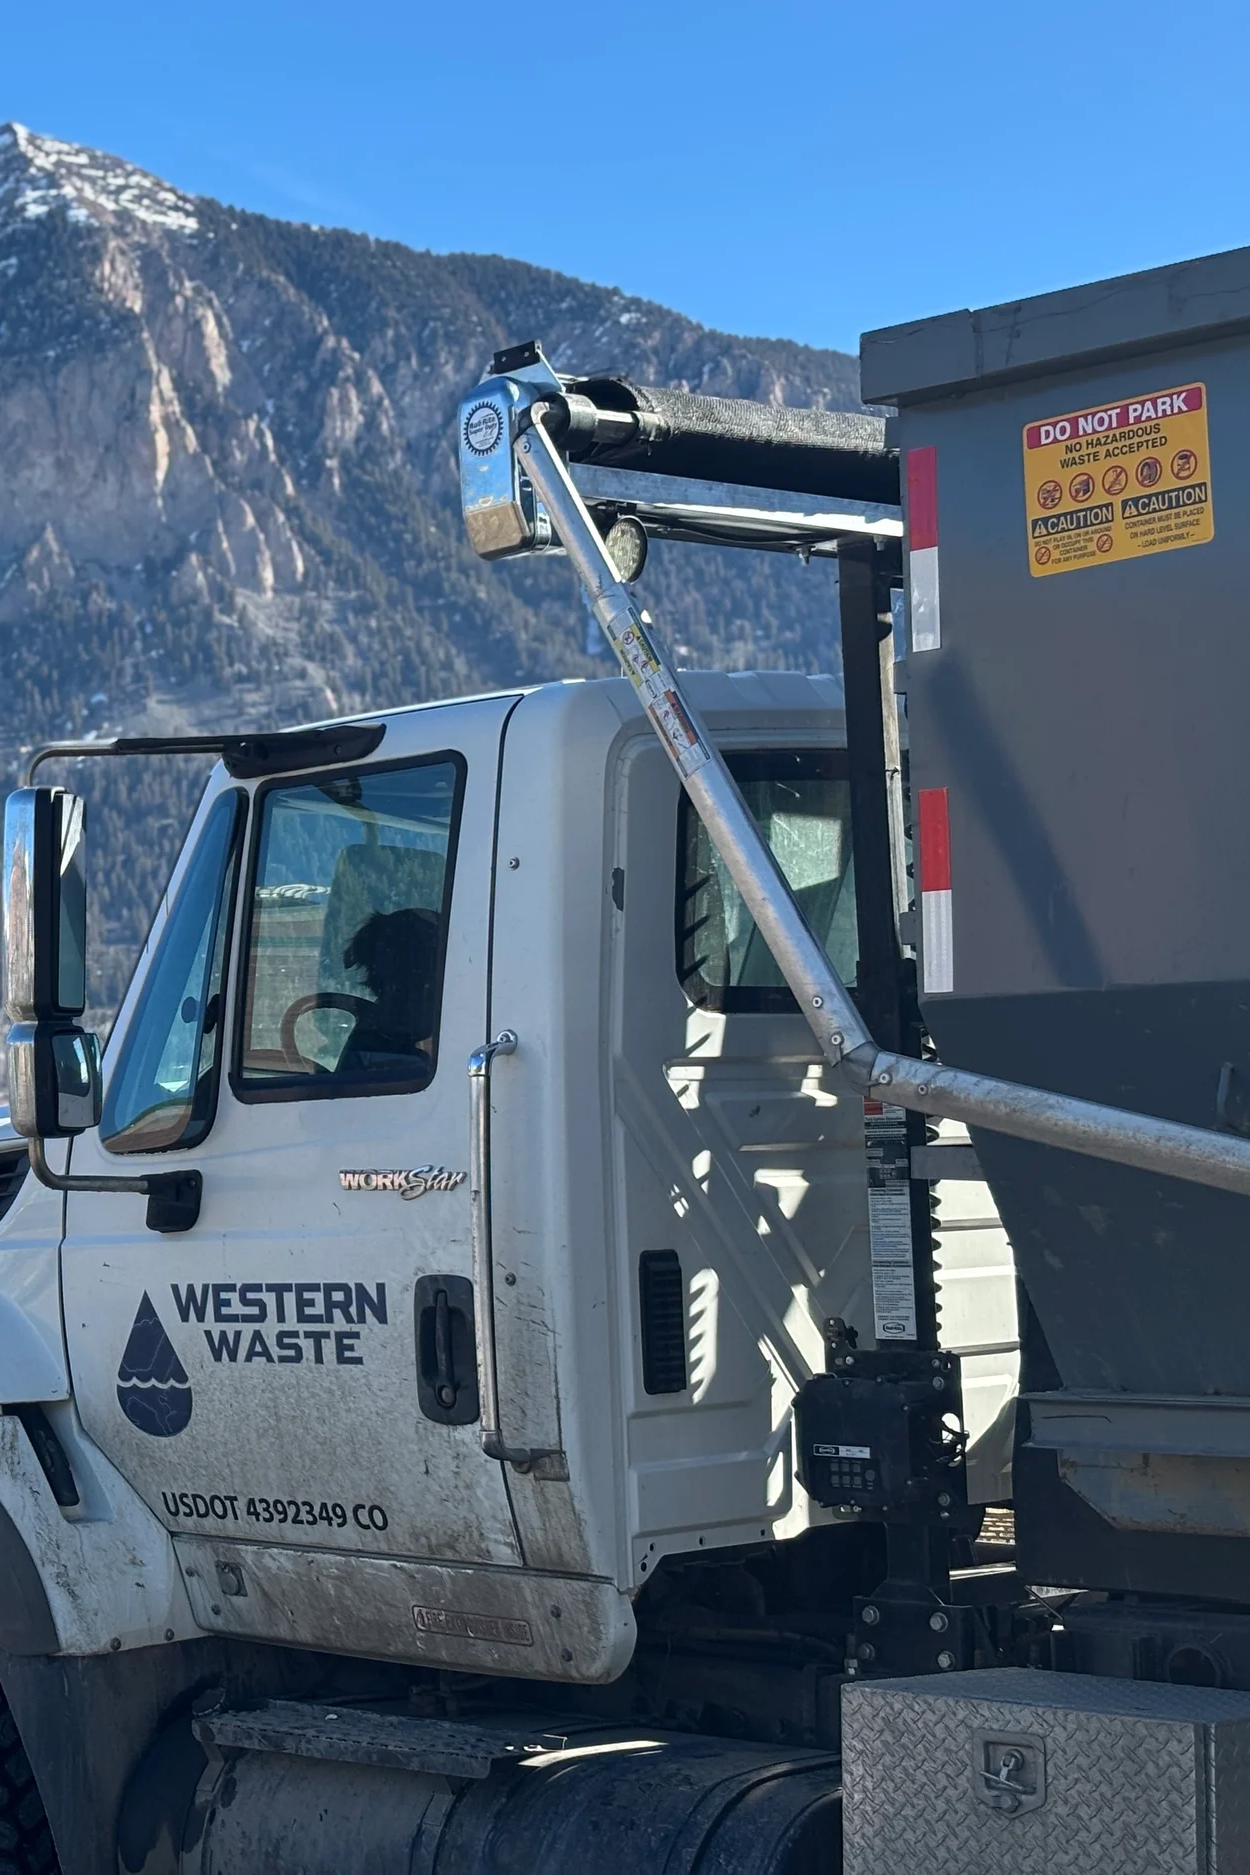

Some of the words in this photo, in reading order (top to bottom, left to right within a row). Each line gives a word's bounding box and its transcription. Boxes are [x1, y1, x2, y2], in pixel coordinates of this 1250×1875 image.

[1040, 421, 1070, 445] DO
[1078, 407, 1120, 436] NOT
[1128, 392, 1188, 424] PARK
[1060, 451, 1100, 469] WASTE
[1104, 436, 1168, 460] ACCEPTED
[1065, 442, 1082, 455] NO
[1086, 423, 1161, 450] HAZARDOUS
[1138, 486, 1206, 513] CAUTION
[1047, 506, 1113, 533] CAUTION
[1125, 517, 1156, 530] CONTAINER
[1157, 514, 1173, 522] MUST
[1182, 506, 1205, 517] PLACED
[1140, 528, 1155, 537] HARD
[1156, 524, 1173, 534] LEVEL
[1174, 518, 1200, 530] SURFACE
[170, 1282, 388, 1325] WESTERN
[204, 1329, 364, 1365] WASTE
[161, 1491, 239, 1521] USDOT
[246, 1497, 348, 1527] 4392349
[353, 1502, 389, 1531] CO
